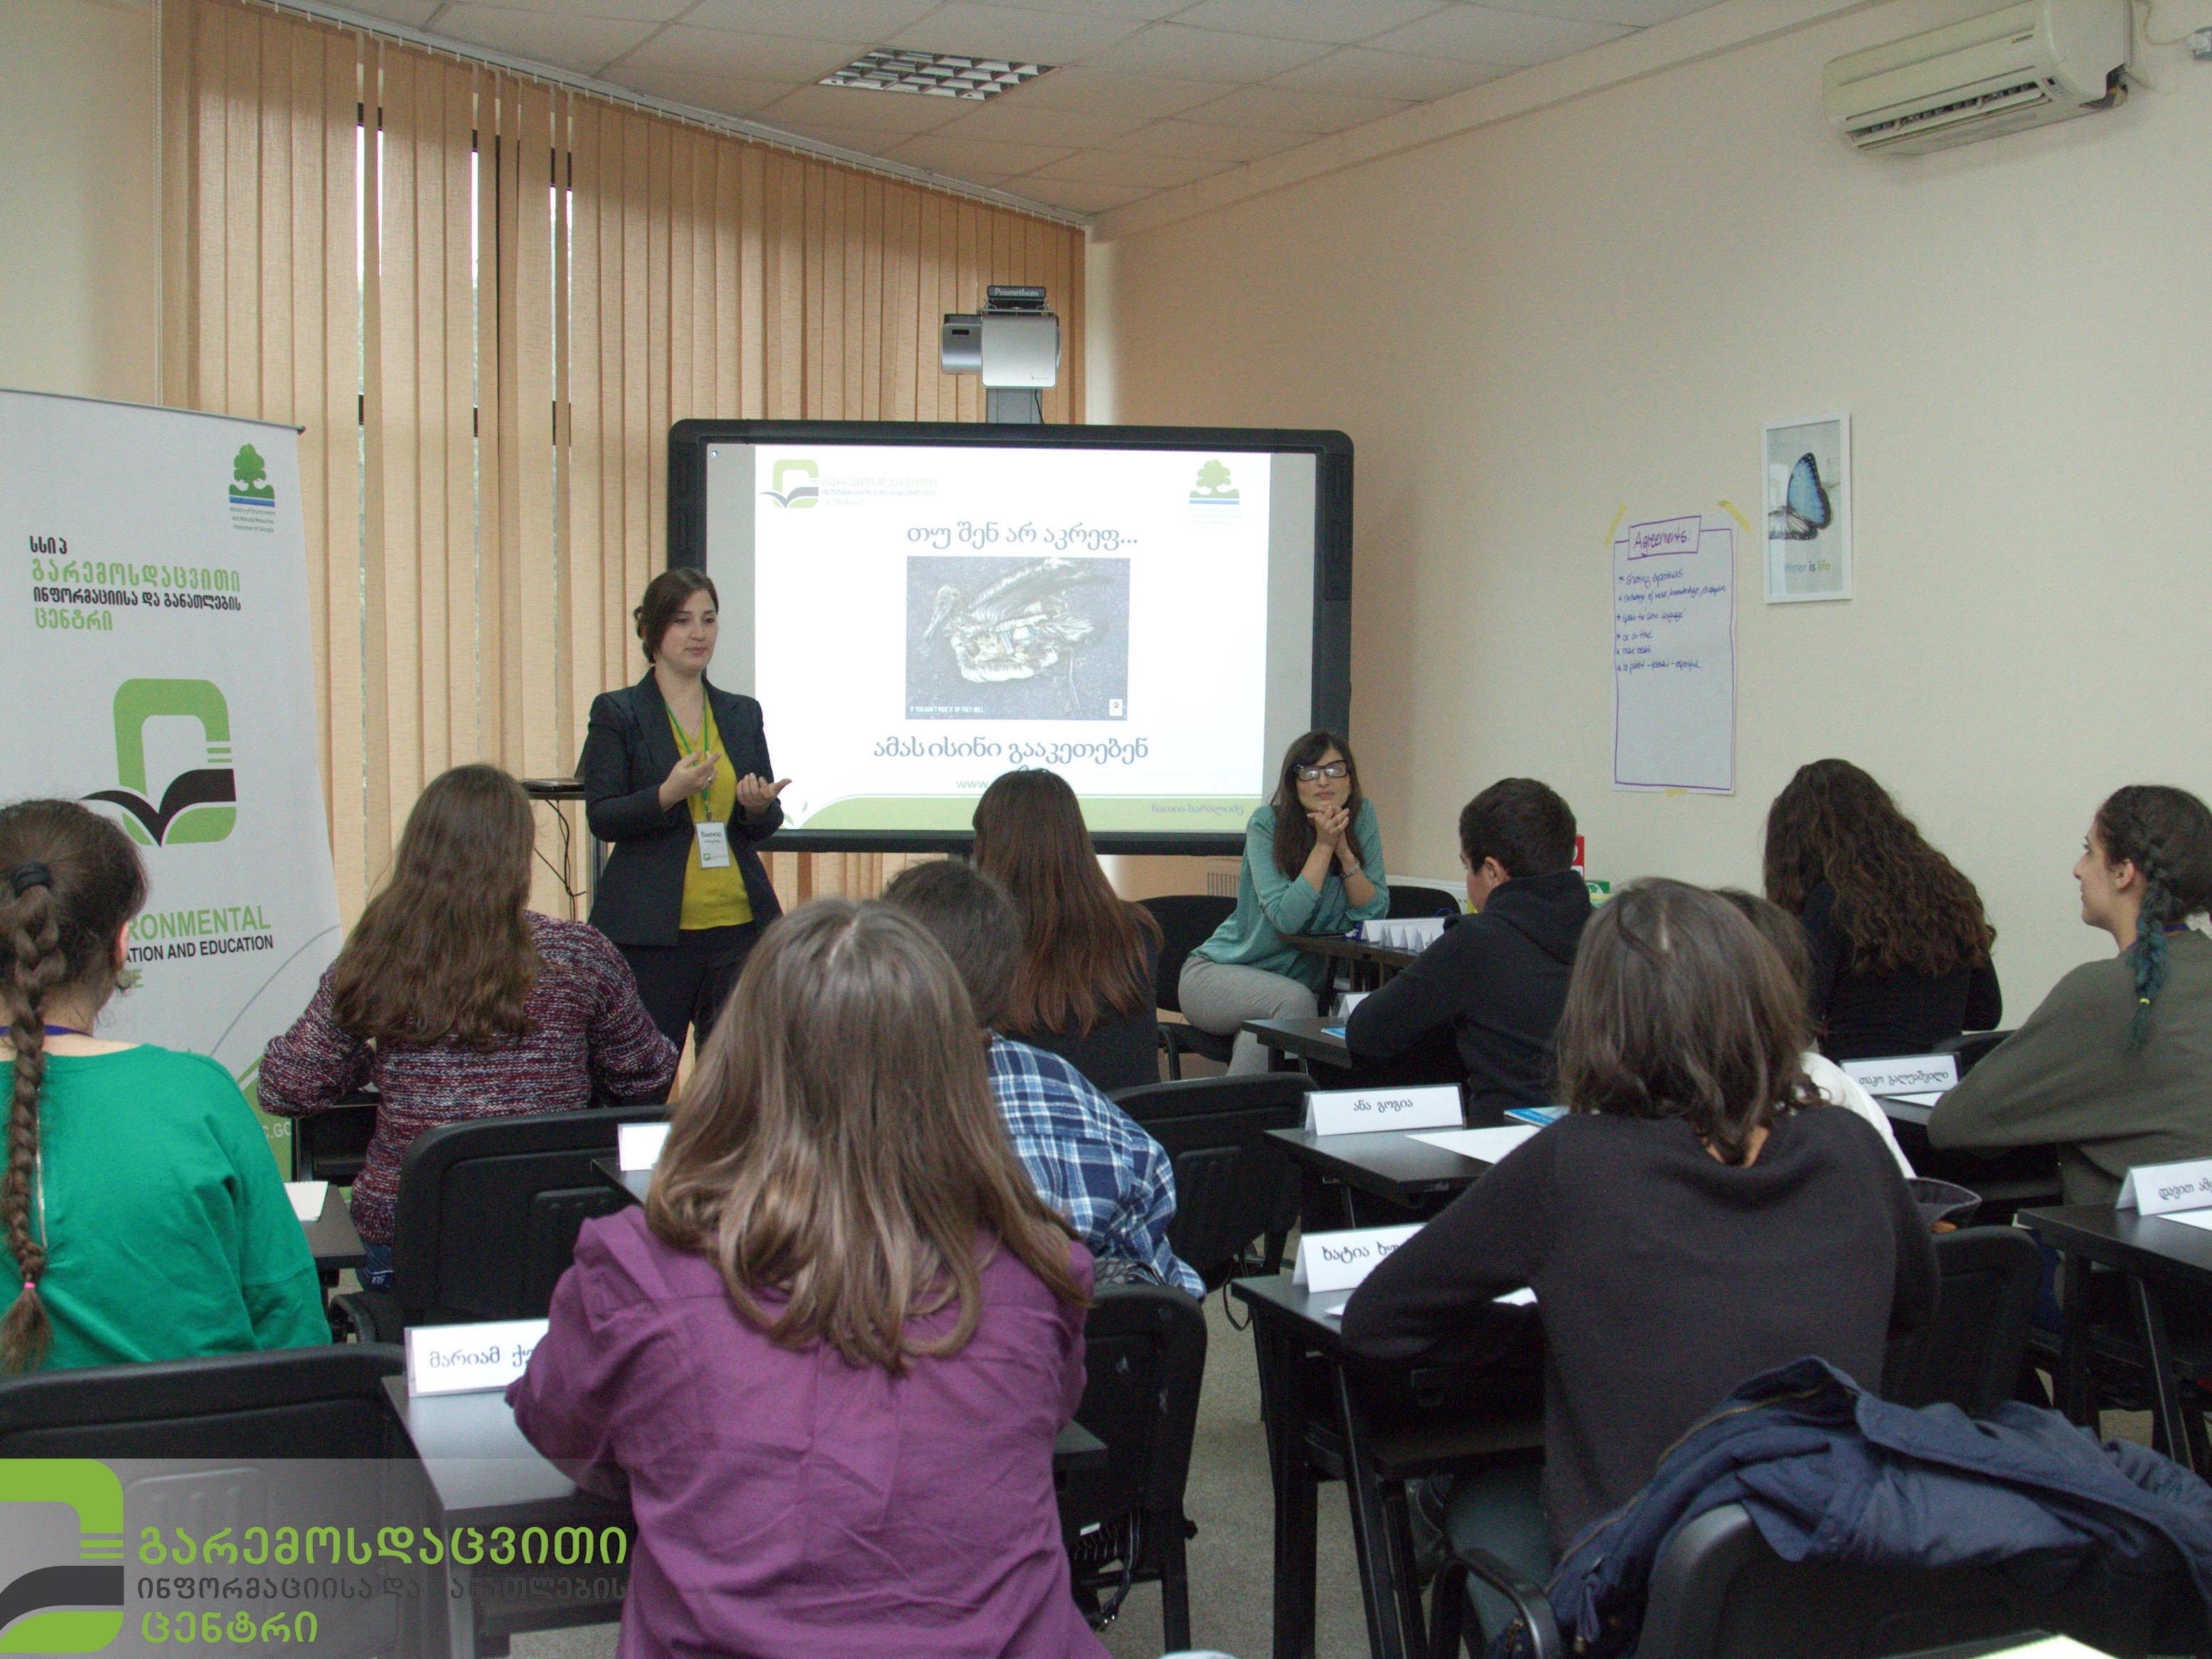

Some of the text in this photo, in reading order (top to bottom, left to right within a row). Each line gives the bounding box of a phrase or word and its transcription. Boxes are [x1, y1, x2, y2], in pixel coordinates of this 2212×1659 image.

[995, 288, 1039, 297] Promethean
[822, 477, 937, 488] გარემოსდაცვითი
[907, 521, 1138, 550] თუ შენ არ აკრეფ...
[31, 558, 240, 592] გარემოსდაცვითი
[1809, 560, 1816, 572] is
[1818, 559, 1832, 571] life
[33, 587, 241, 611] ინფორმაციისა და განათლების
[35, 608, 113, 631] ცენტრი
[873, 736, 1148, 764] ამას ისინი გააკეთებენ
[1152, 804, 1244, 816] ნათია სარალიძე
[168, 942, 196, 959] AND
[200, 934, 274, 956] EDUCATION
[1354, 1099, 1413, 1113] ანა გოგია
[2159, 1184, 2194, 1200] დავით
[1321, 1246, 1369, 1264] ხატია
[429, 1345, 501, 1368] მარიამ
